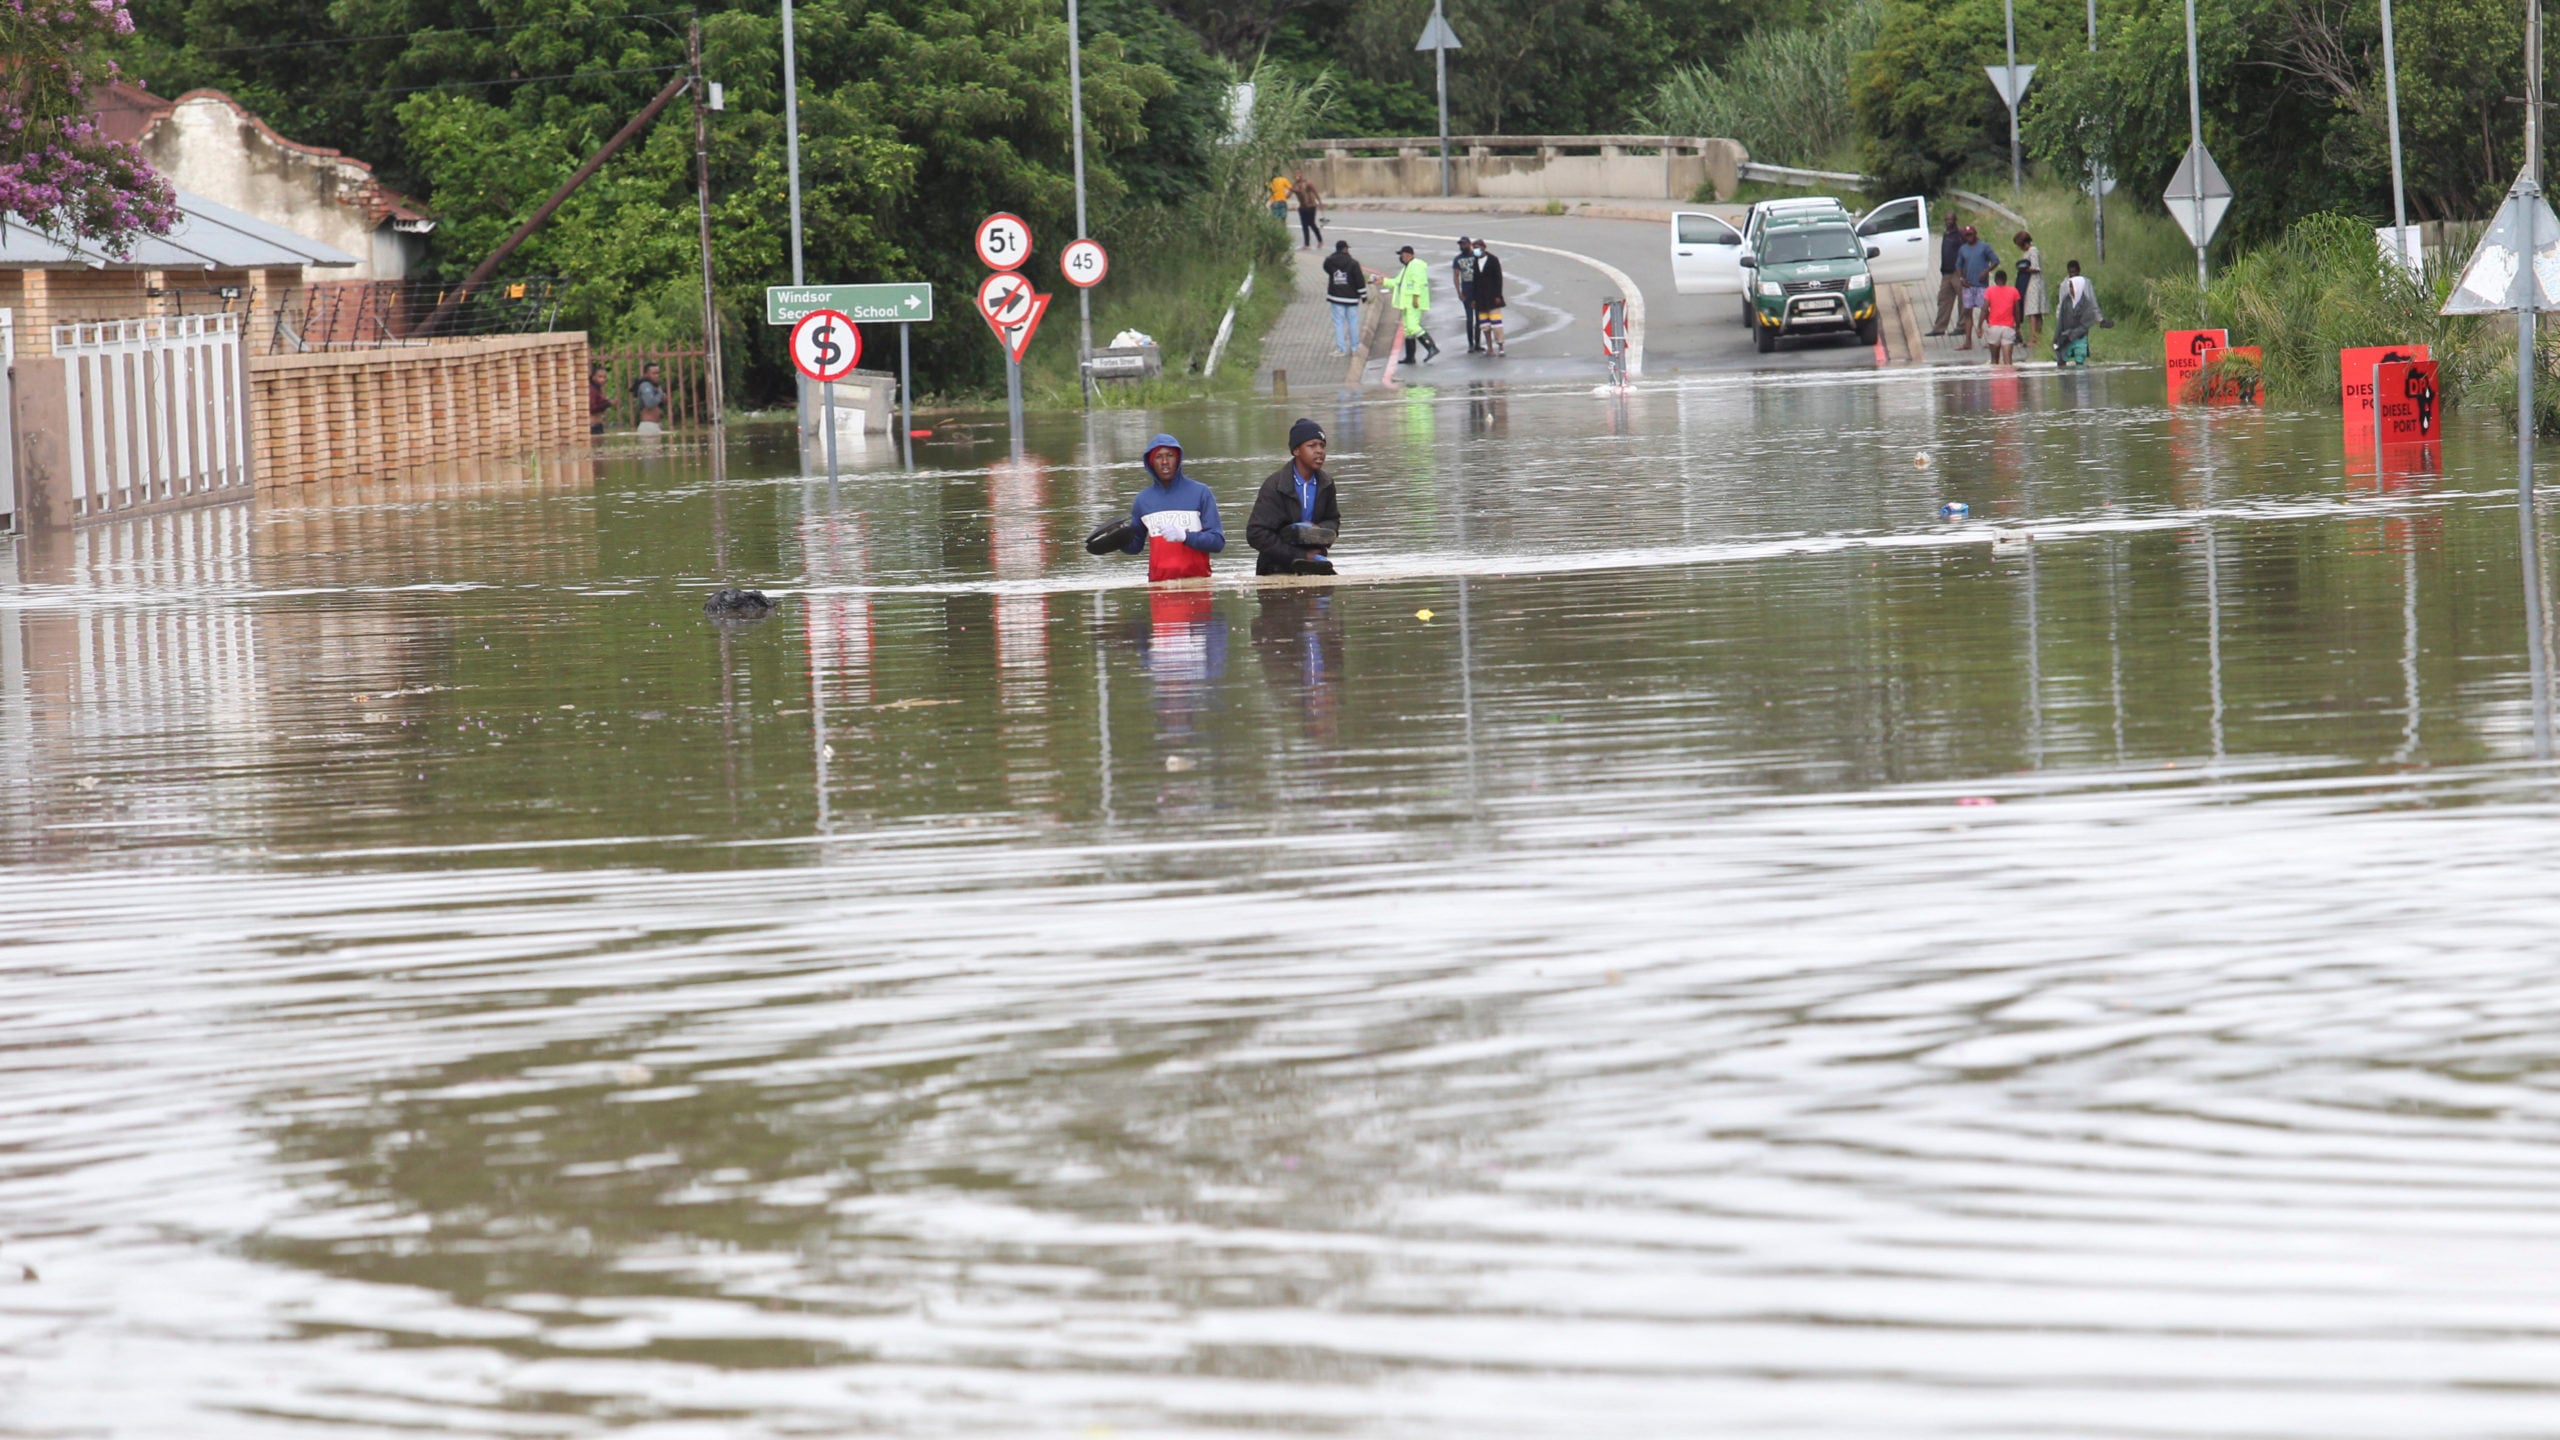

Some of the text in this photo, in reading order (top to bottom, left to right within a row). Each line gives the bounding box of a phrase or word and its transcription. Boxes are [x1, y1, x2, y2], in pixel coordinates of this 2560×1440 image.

[988, 227, 1016, 254] 5t
[1072, 252, 1094, 270] 45
[776, 290, 833, 304] Windsor
[854, 305, 899, 318] School
[2168, 358, 2198, 369] DIESEL
[2346, 383, 2374, 396] DIES
[2408, 378, 2427, 395] DP
[2382, 402, 2413, 418] DIESEL
[2393, 418, 2417, 433] PORT
